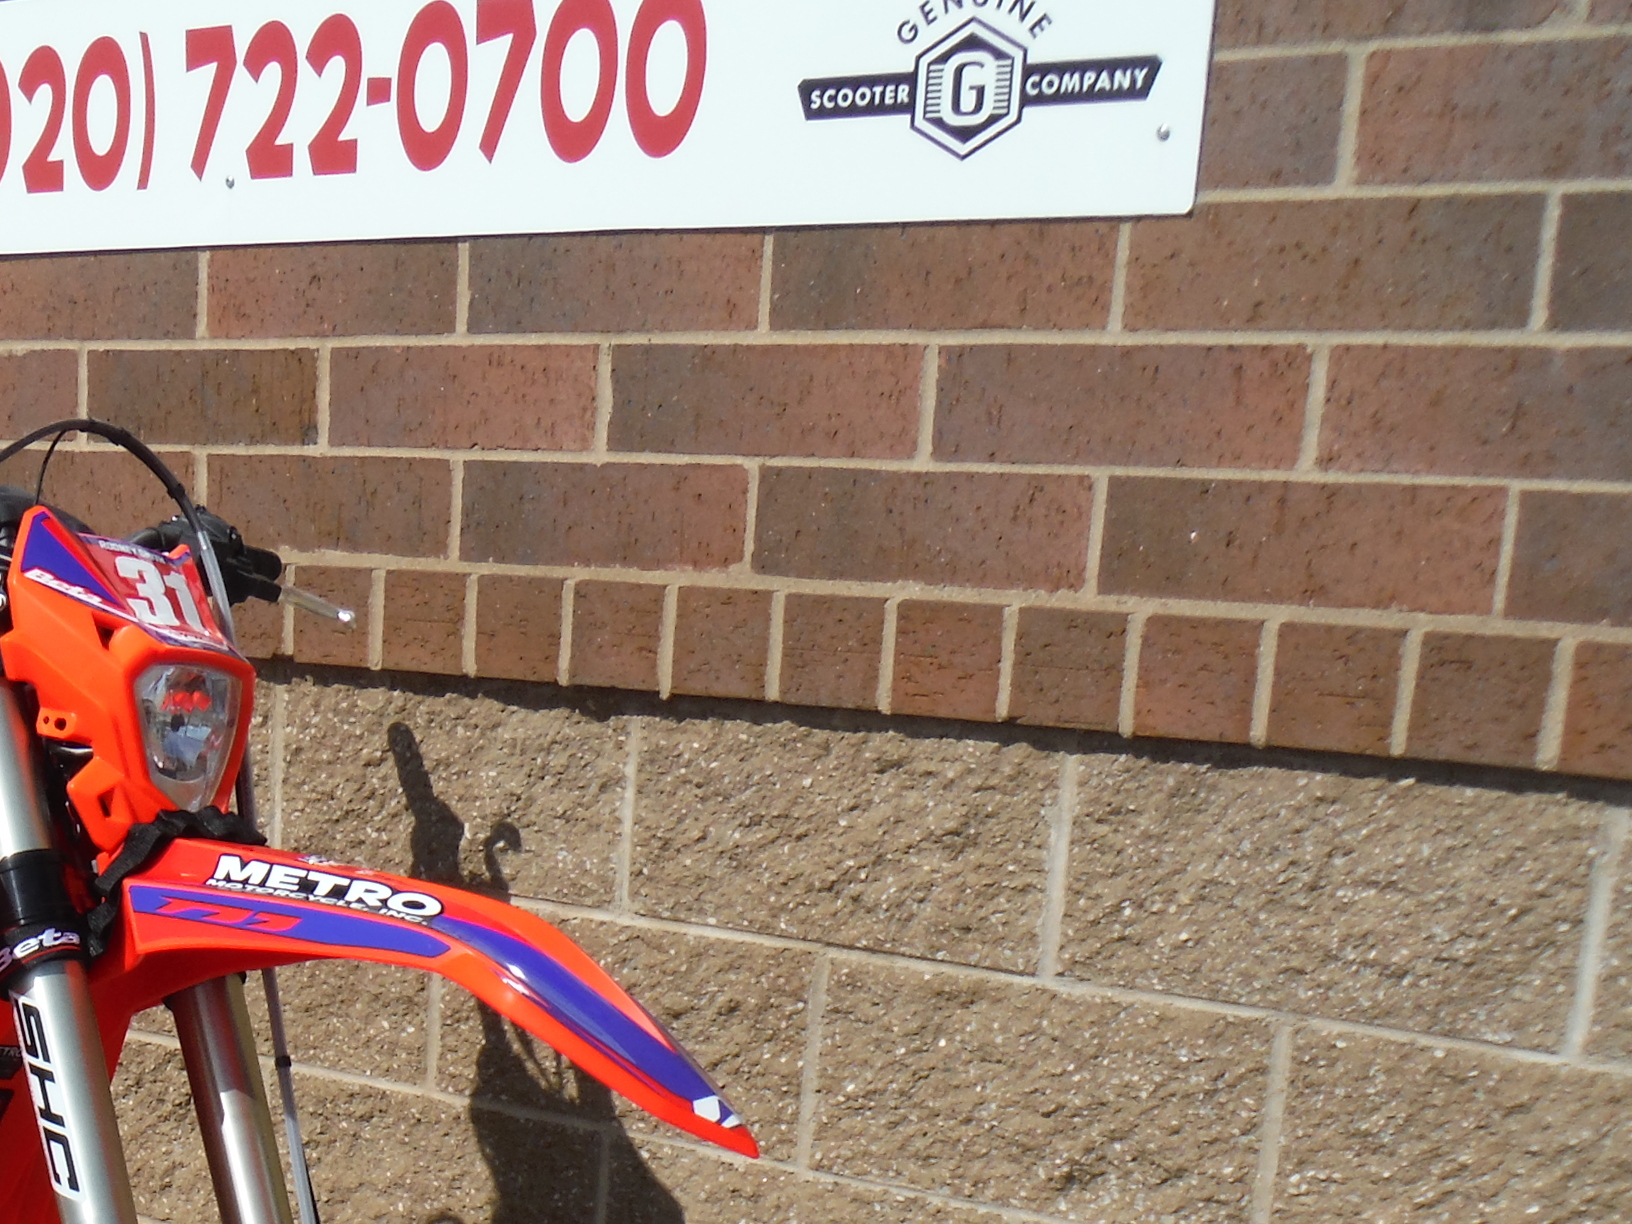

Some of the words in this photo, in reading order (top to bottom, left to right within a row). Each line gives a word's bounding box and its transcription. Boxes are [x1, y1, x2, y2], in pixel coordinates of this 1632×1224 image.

[185, 0, 708, 182] 722-0700
[809, 83, 910, 110] SCOOTER
[1024, 66, 1150, 97] COMPANY
[24, 568, 104, 605] Beta
[114, 555, 210, 637] 31
[213, 854, 443, 917] METRO
[378, 907, 429, 926] INC.
